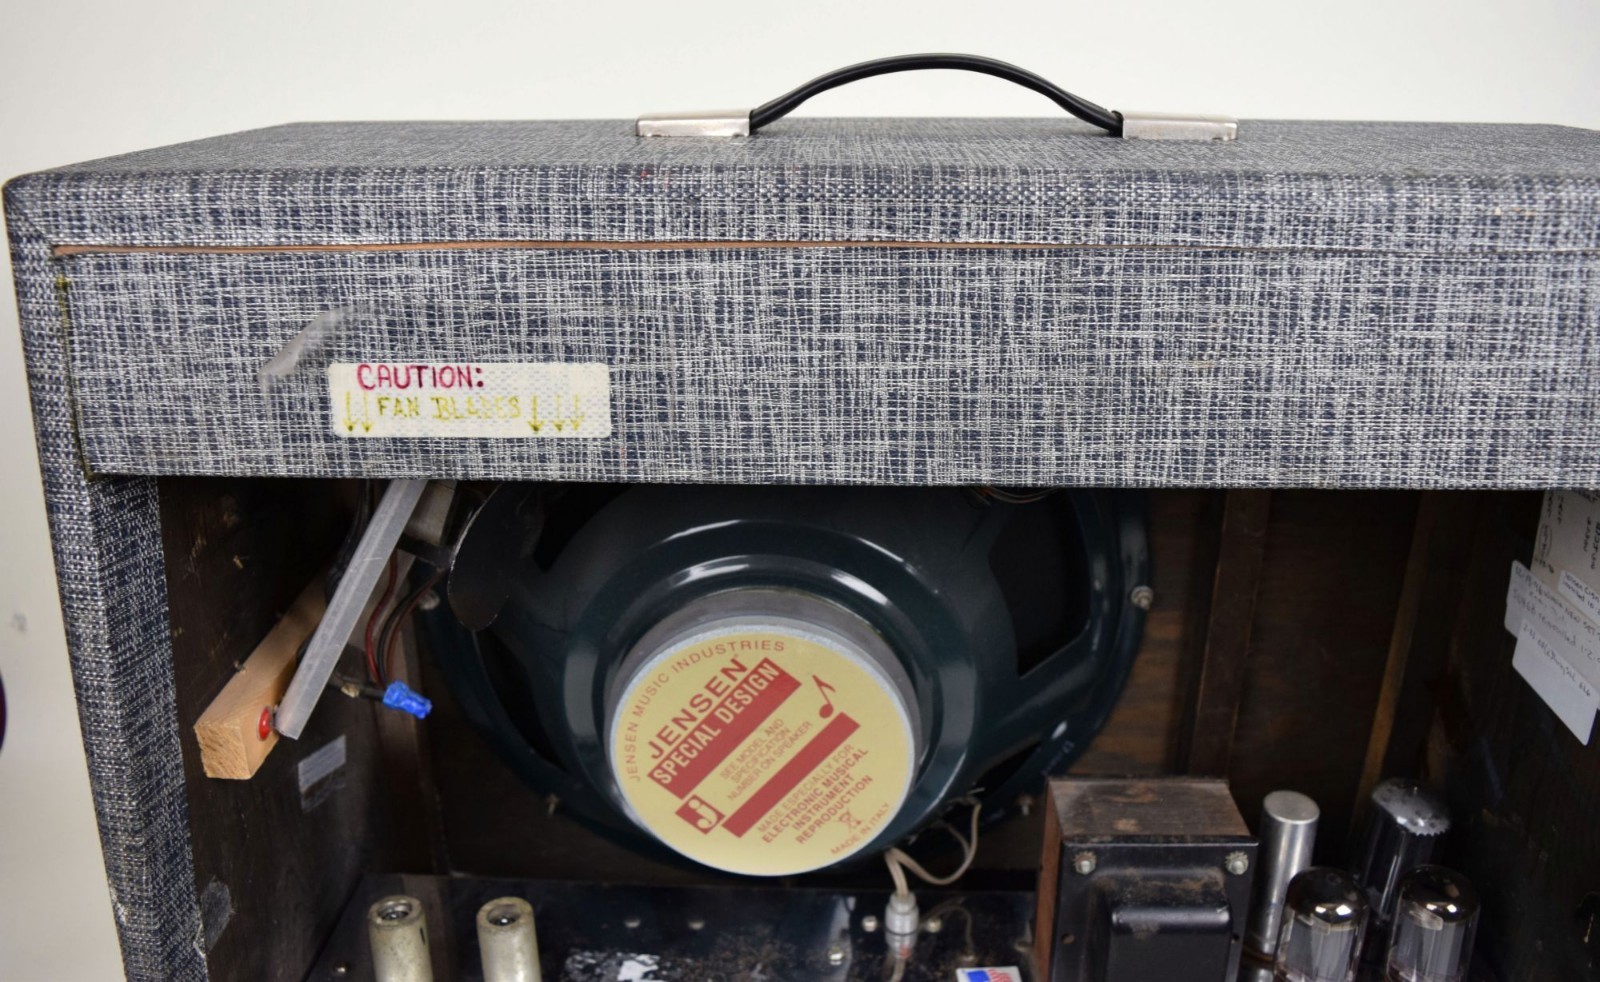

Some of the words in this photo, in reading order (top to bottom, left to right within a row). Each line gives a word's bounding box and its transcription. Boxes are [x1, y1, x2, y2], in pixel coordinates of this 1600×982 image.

[356, 364, 484, 392] CAUTION:
[376, 396, 420, 418] FAN
[671, 640, 785, 674] INDUSTRIES
[632, 672, 670, 718] MUSIC
[647, 657, 748, 760] JENSEN
[653, 724, 722, 785] SPECIAL
[714, 662, 780, 725] DESIGN
[764, 718, 785, 737] AND
[773, 721, 813, 757] SPEAKER
[624, 722, 641, 782] JENSEN
[757, 809, 783, 832] MADE
[782, 763, 833, 809] ESPECIALLY
[832, 743, 854, 763] FOR
[762, 787, 824, 843] ELECTRONIC
[821, 748, 869, 789] MUSICAL
[792, 773, 856, 831] INSTRUMENT
[795, 775, 873, 844] REPRODUCTION
[830, 835, 860, 855] MADE
